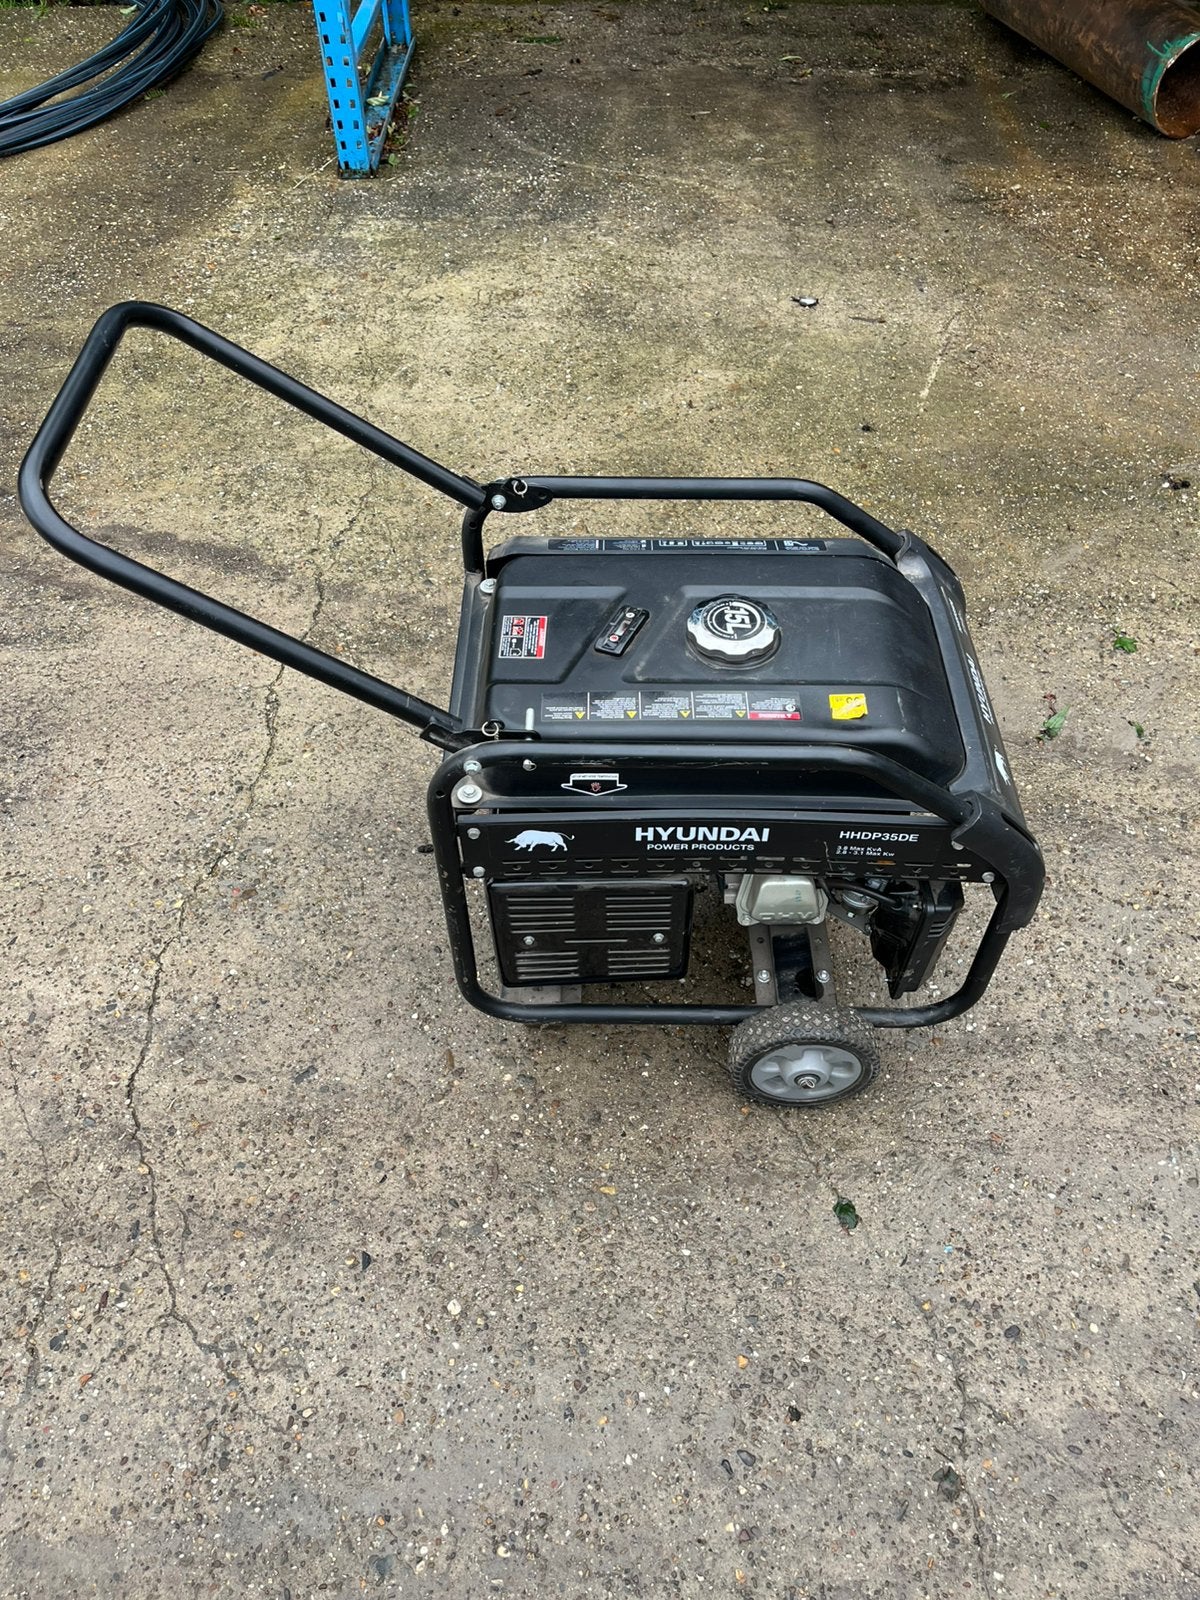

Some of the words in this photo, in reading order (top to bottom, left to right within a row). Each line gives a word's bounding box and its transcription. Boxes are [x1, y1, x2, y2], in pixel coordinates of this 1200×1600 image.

[724, 607, 752, 634] 15L
[635, 826, 770, 842] HYUNDAI
[839, 830, 920, 842] HHDP35DE
[646, 843, 689, 851] POWER
[691, 843, 755, 851] PRODUCTS
